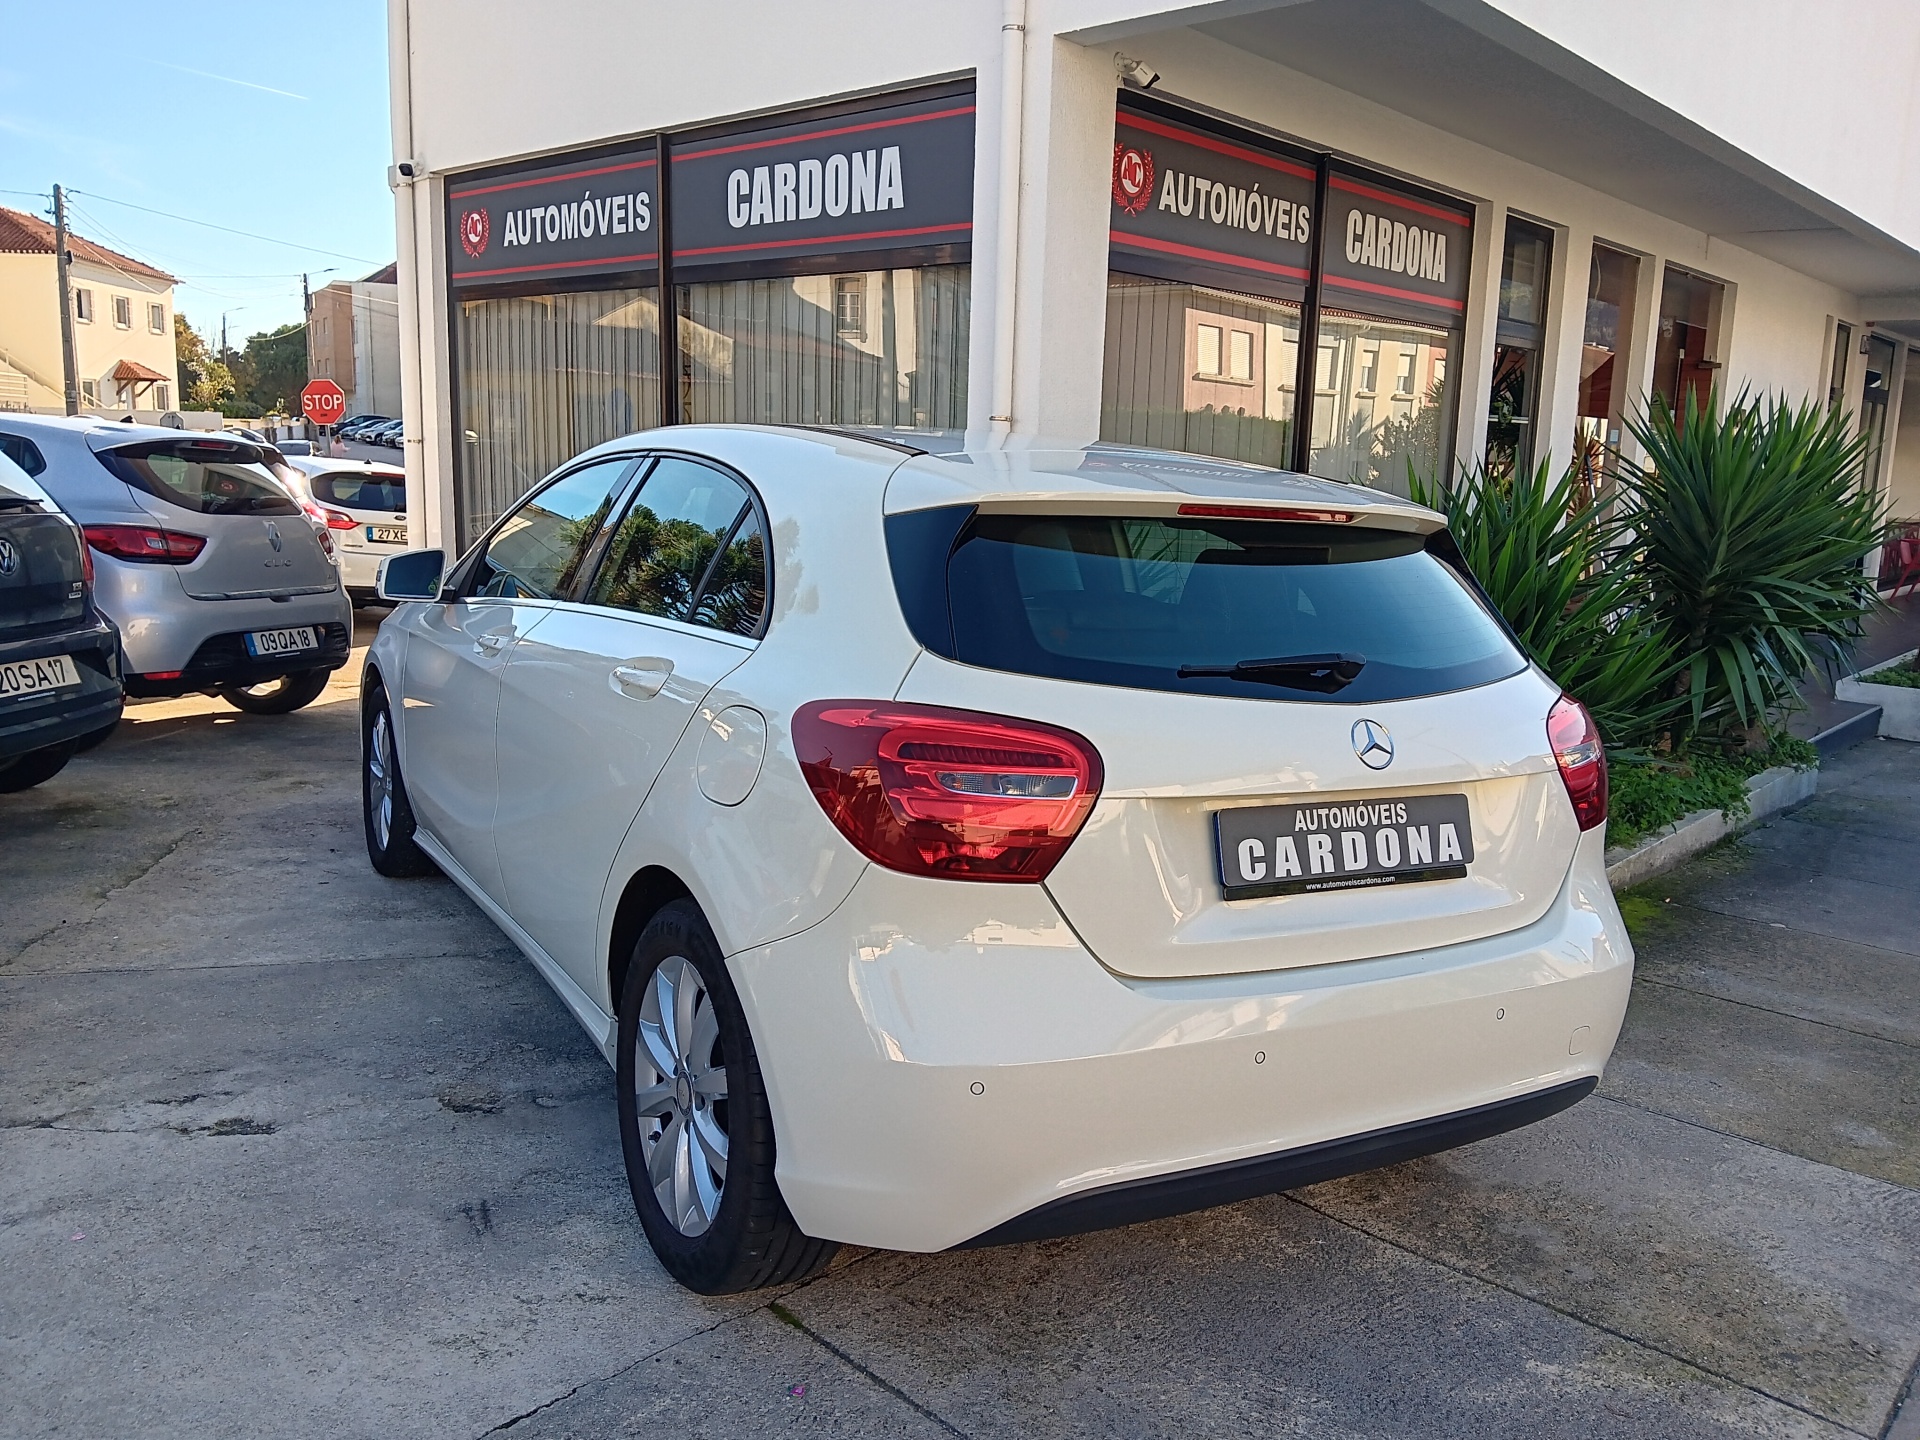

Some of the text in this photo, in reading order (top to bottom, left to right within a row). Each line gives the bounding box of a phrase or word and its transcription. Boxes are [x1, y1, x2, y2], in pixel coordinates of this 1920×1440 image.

[503, 191, 651, 247] AUTOMÓVEIS
[727, 145, 905, 229] CARDONA
[1158, 169, 1310, 244] AUTOMÓVEIS
[1345, 209, 1447, 283] CARDONA
[303, 394, 342, 410] STOP
[1294, 801, 1408, 832] AUTOMÓVEIS
[1237, 823, 1464, 882] CARDONA
[1305, 876, 1396, 890] www.automoveiscardona.com
